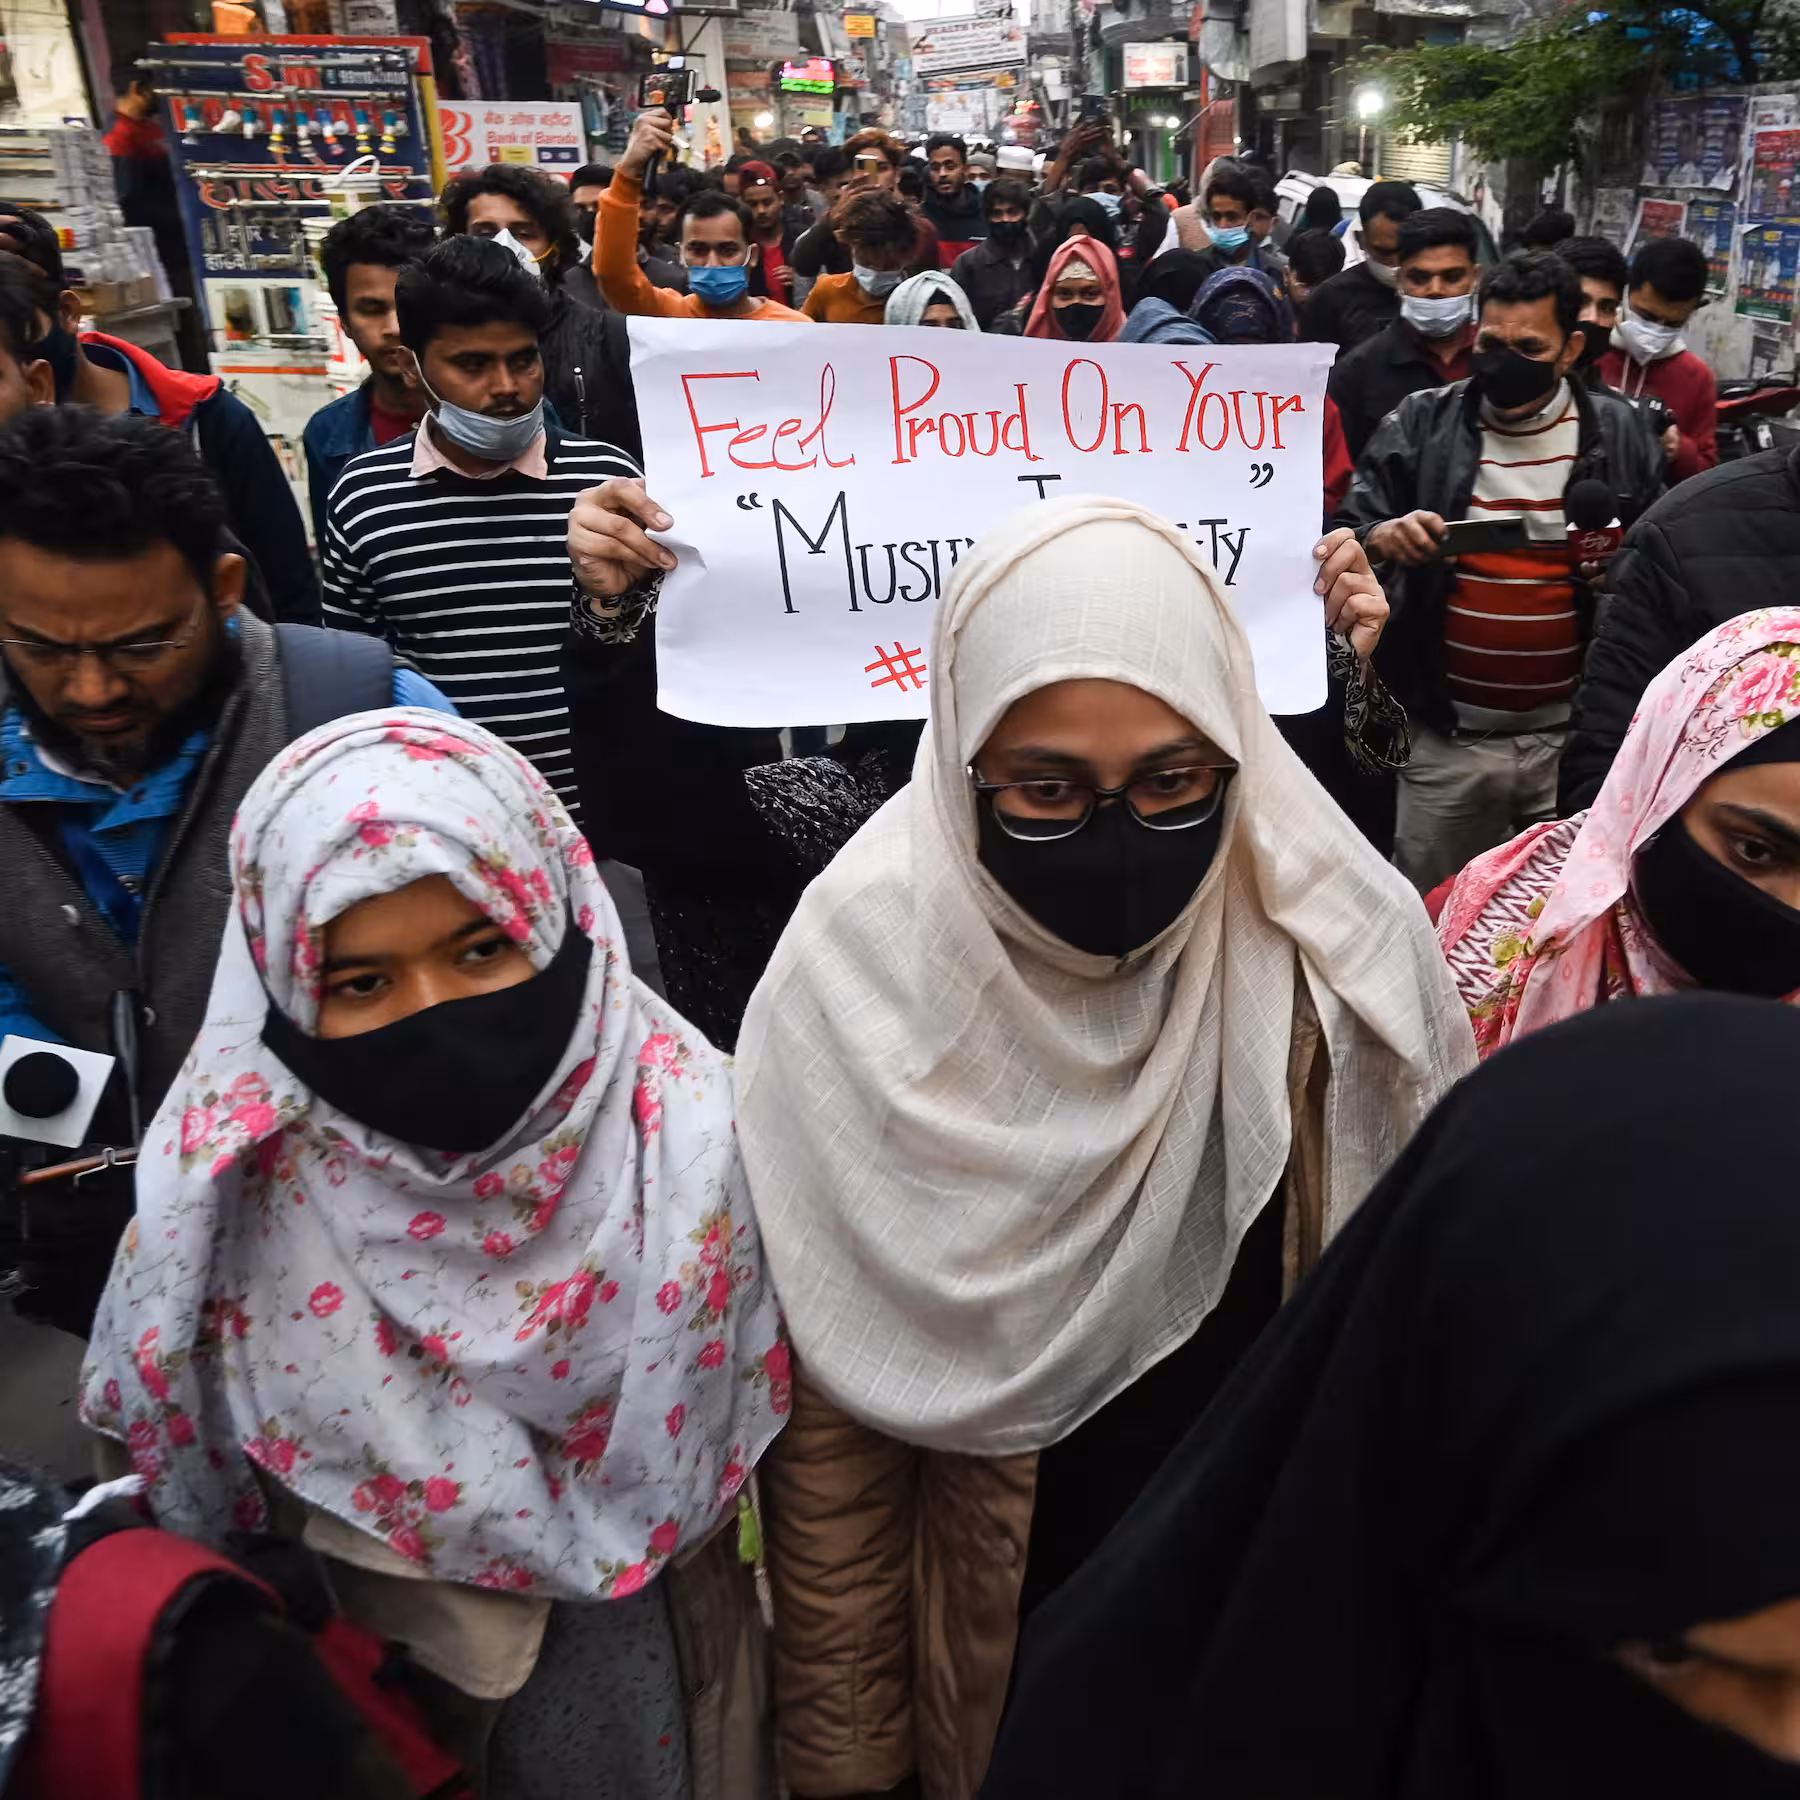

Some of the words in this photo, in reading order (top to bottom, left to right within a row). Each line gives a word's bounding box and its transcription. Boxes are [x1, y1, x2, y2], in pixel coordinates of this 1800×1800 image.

[487, 131, 517, 145] Bank
[521, 131, 534, 145] of
[536, 131, 578, 145] Baroda
[681, 362, 857, 479] Feel
[889, 355, 1043, 465] Proud
[1061, 358, 1154, 455] On
[1171, 360, 1306, 453] Your
